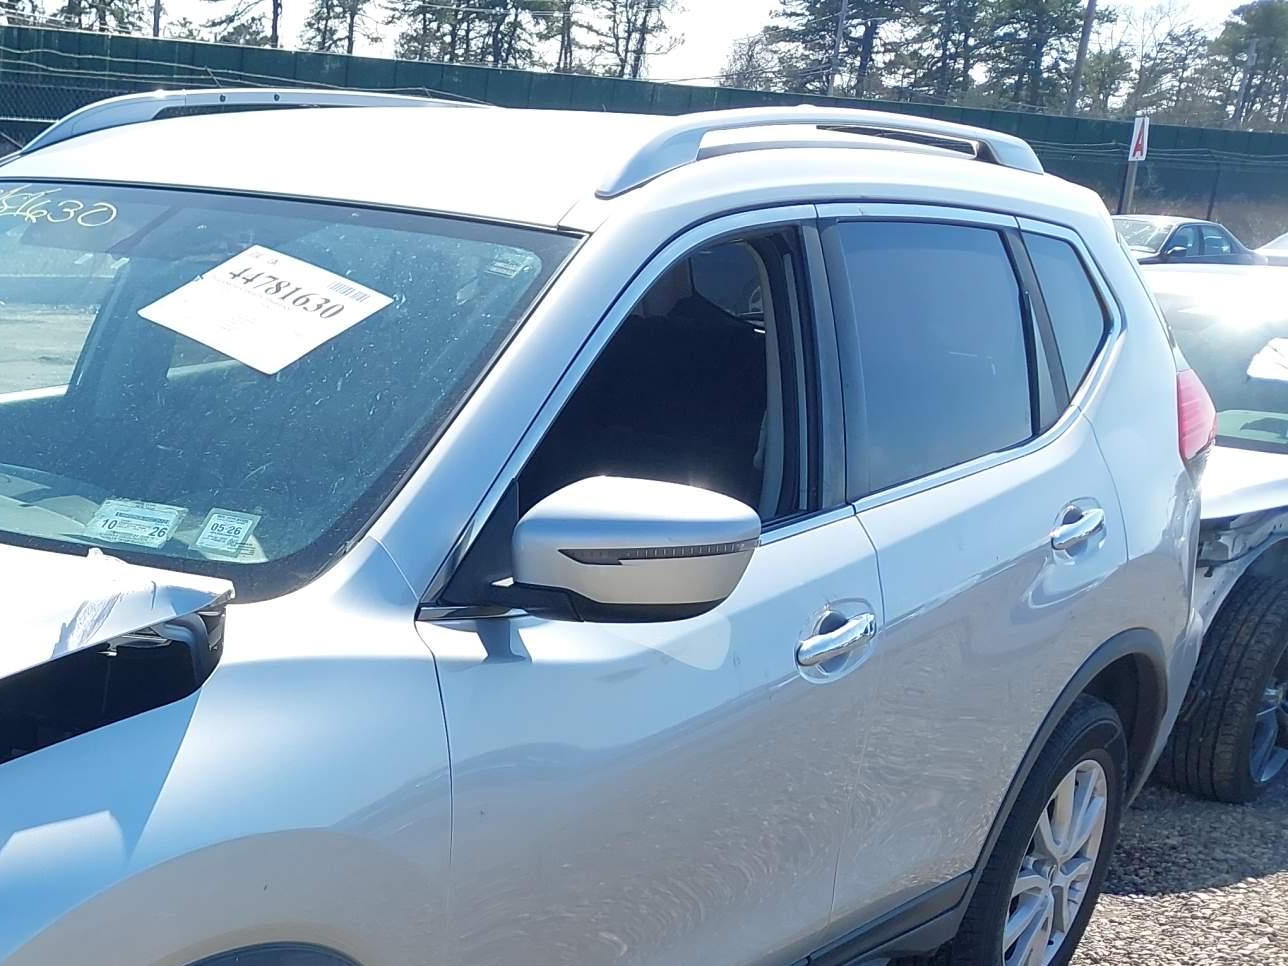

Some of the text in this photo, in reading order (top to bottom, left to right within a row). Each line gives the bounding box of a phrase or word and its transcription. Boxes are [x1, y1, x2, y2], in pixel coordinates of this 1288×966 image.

[1132, 118, 1145, 157] A
[229, 267, 345, 319] 44781630
[101, 519, 118, 530] 10
[148, 526, 169, 538] 26
[210, 522, 243, 536] 05 26
